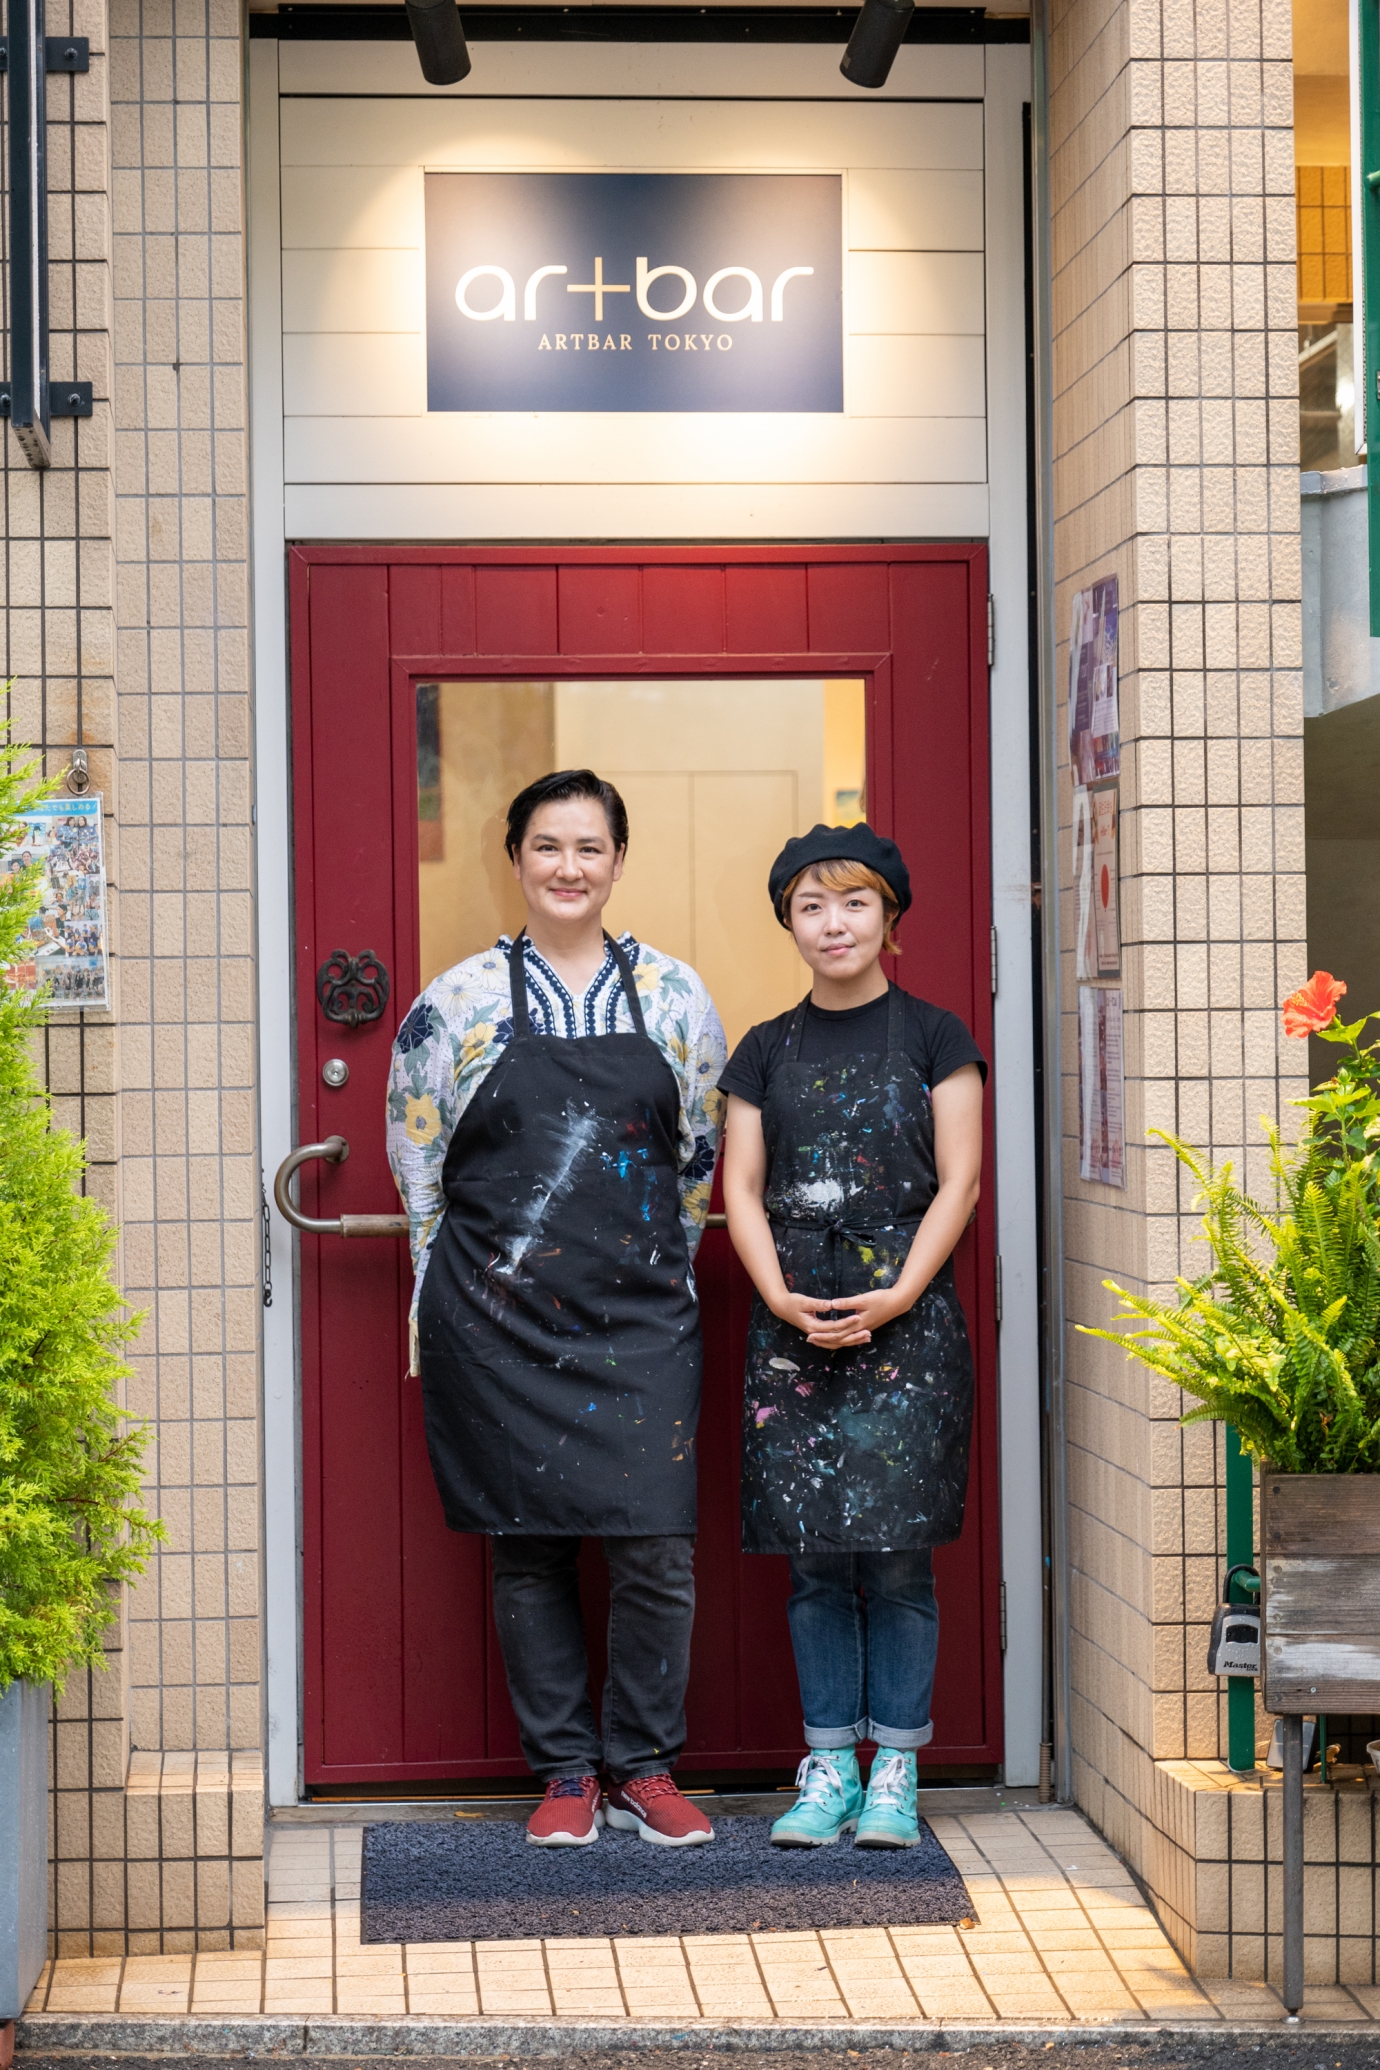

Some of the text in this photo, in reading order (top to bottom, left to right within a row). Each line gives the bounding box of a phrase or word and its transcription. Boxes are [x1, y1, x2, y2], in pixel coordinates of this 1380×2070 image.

[538, 333, 734, 351] ARTBAR TOKYO
[1223, 1661, 1257, 1669] Master
